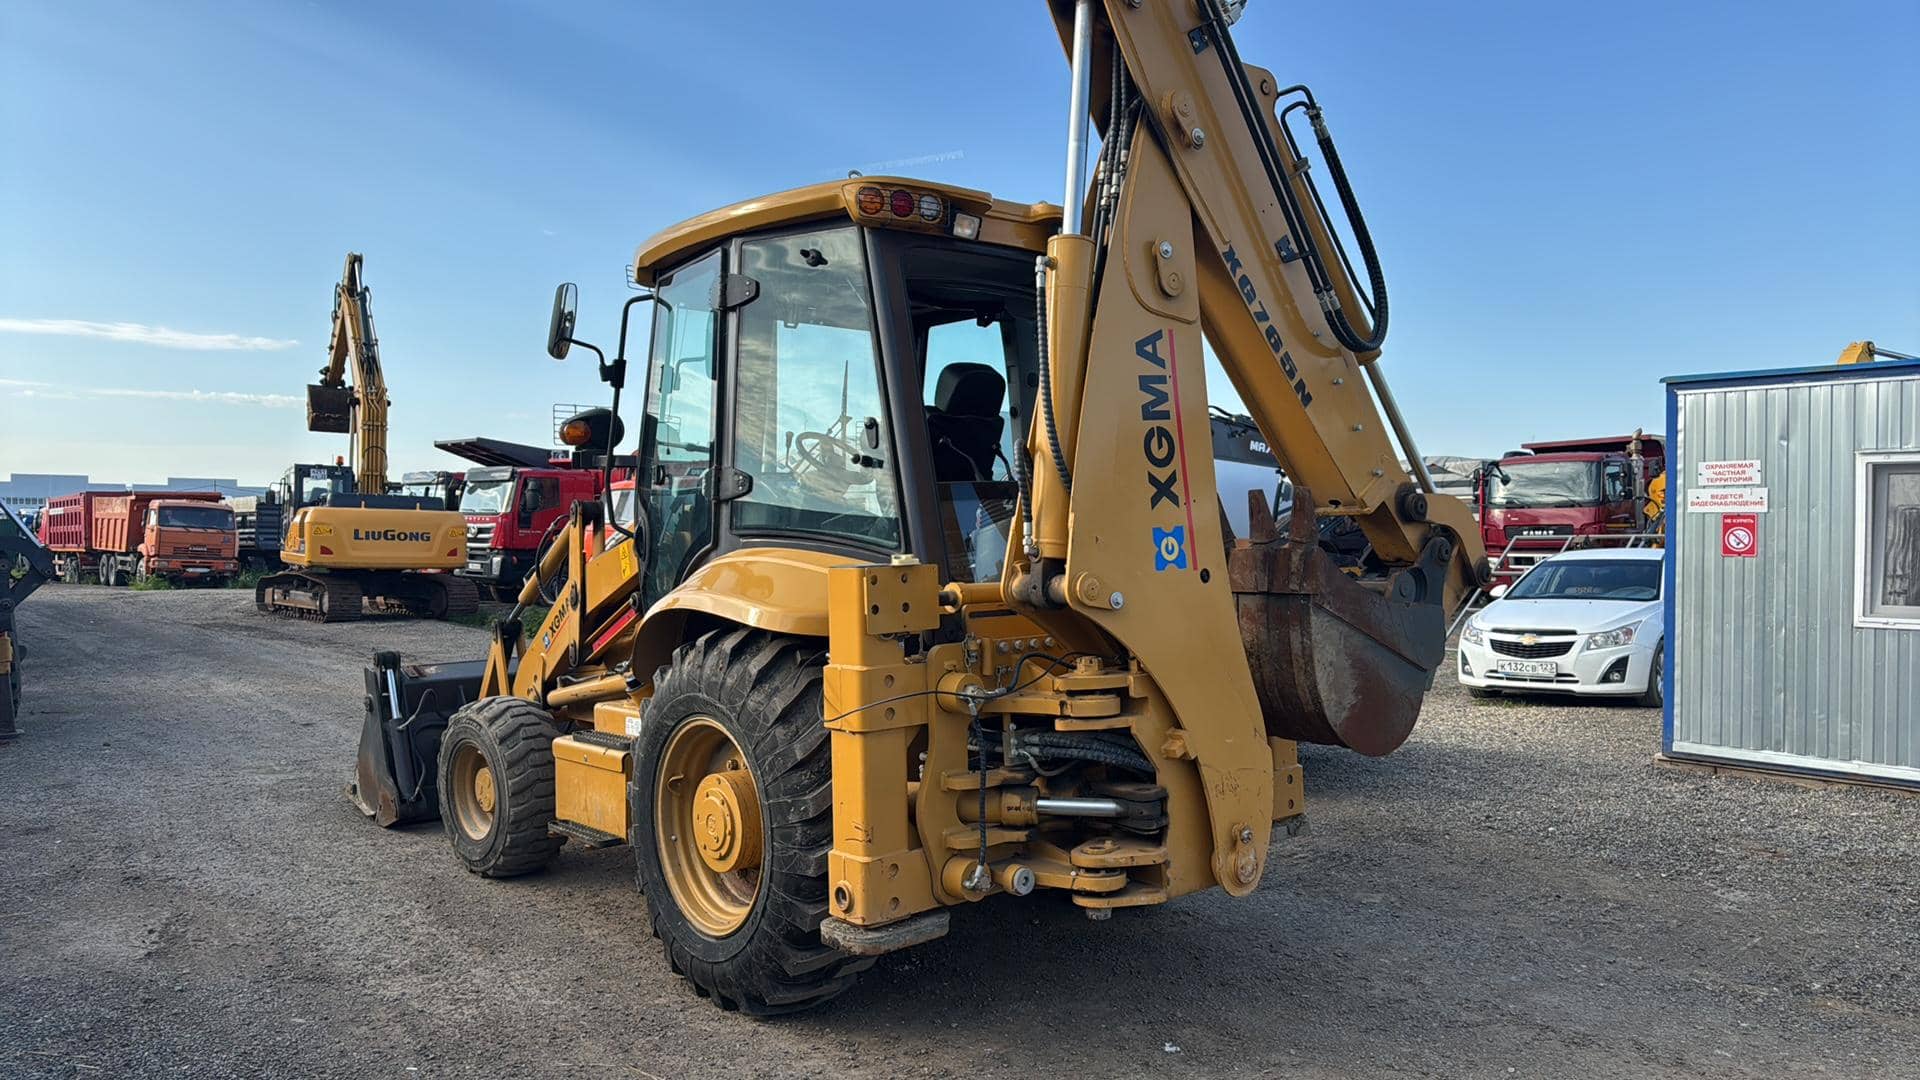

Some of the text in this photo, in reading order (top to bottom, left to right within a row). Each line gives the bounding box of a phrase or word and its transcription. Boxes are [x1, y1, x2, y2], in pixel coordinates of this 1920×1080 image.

[1222, 244, 1313, 408] XG765N
[1135, 328, 1180, 510] XGMA
[1705, 462, 1754, 470] ОХРАНЯЕМАЯ
